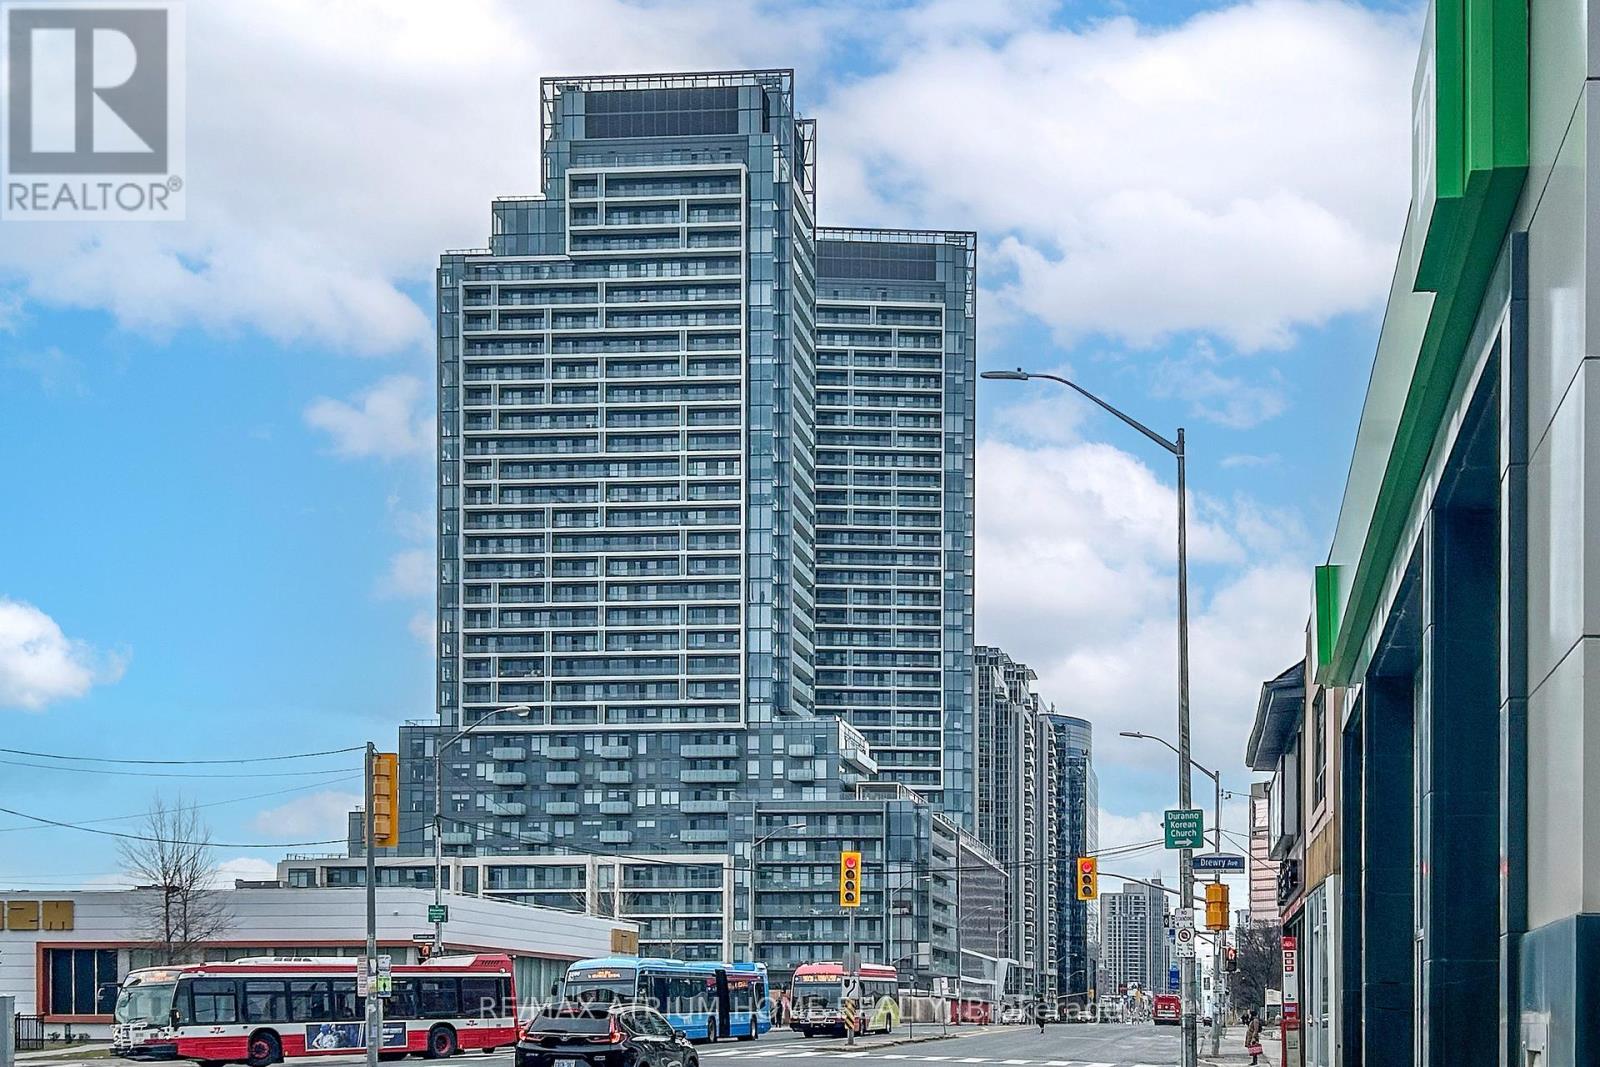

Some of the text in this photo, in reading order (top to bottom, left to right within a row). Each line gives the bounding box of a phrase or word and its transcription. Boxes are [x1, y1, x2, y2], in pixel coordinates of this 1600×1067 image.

[1167, 812, 1199, 820] Duranno
[1170, 821, 1197, 829] Korean
[1170, 829, 1197, 837] Church
[1200, 858, 1226, 867] Drewry
